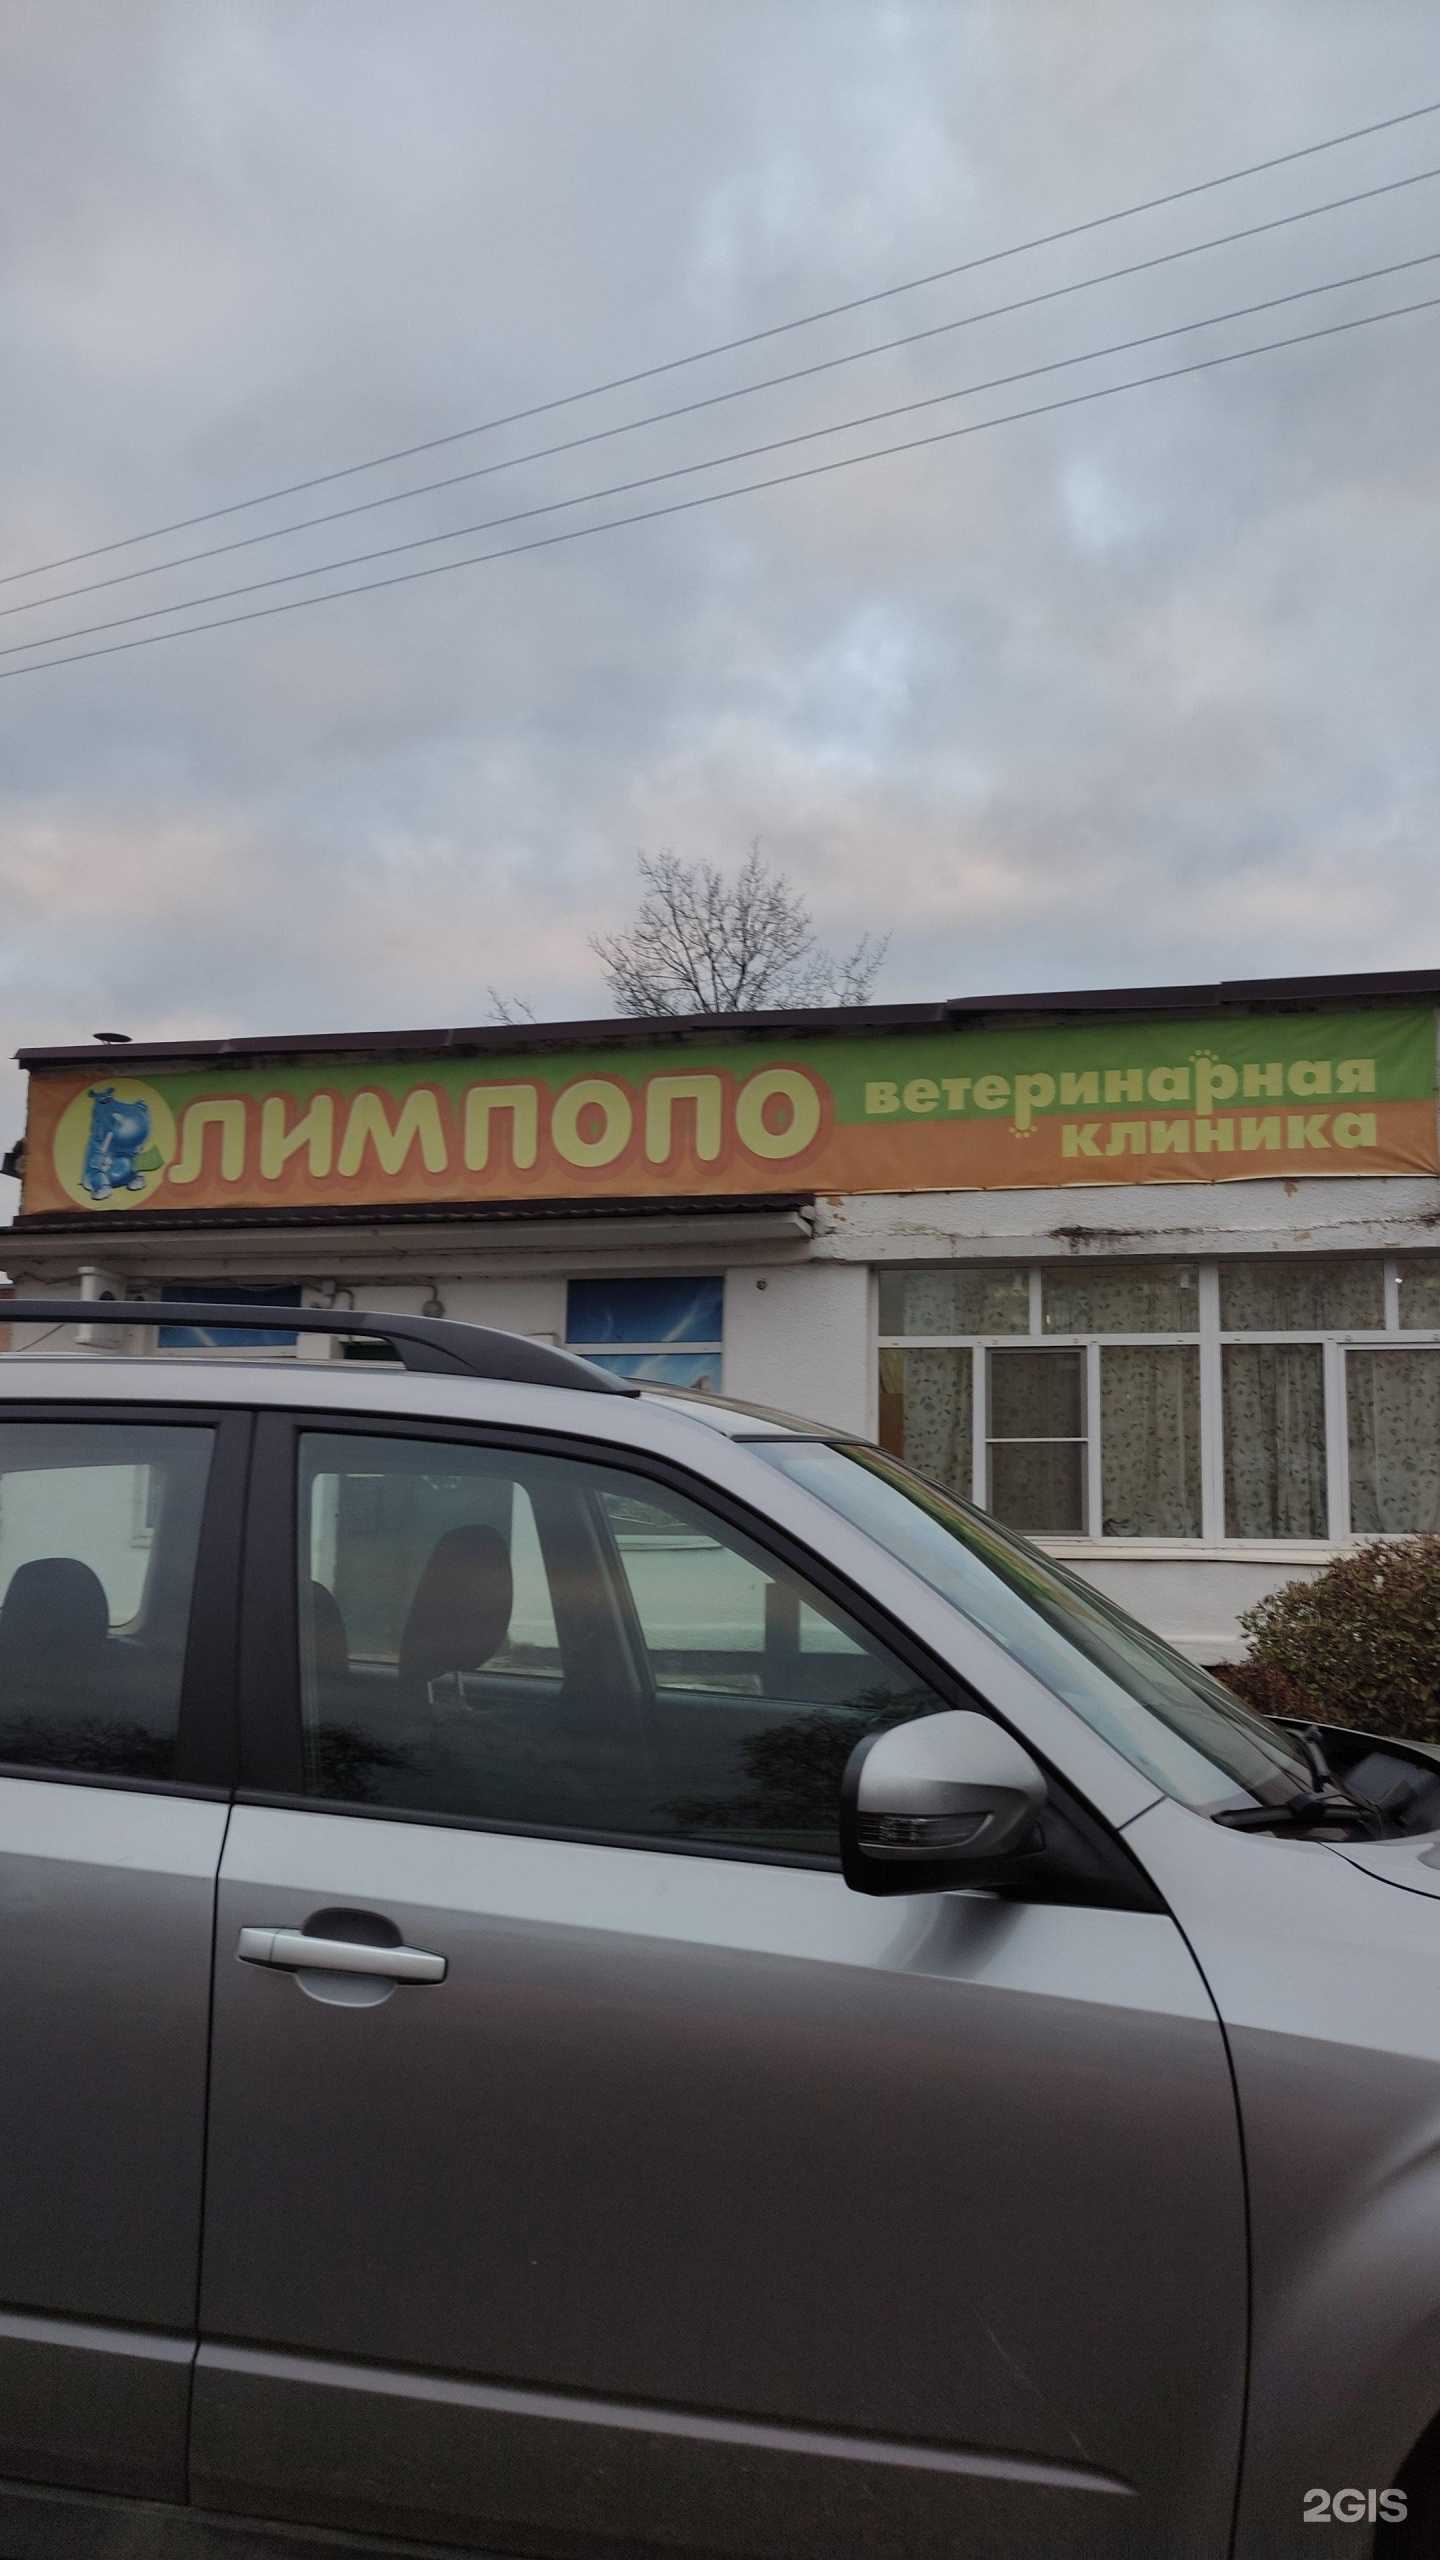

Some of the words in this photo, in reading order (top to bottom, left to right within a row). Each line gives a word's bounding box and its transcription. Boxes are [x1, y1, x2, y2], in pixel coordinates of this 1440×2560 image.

[168, 1068, 822, 1184] ЛИМПОПО
[864, 1053, 1377, 1133] ветеринарная
[1060, 1112, 1377, 1158] клиника
